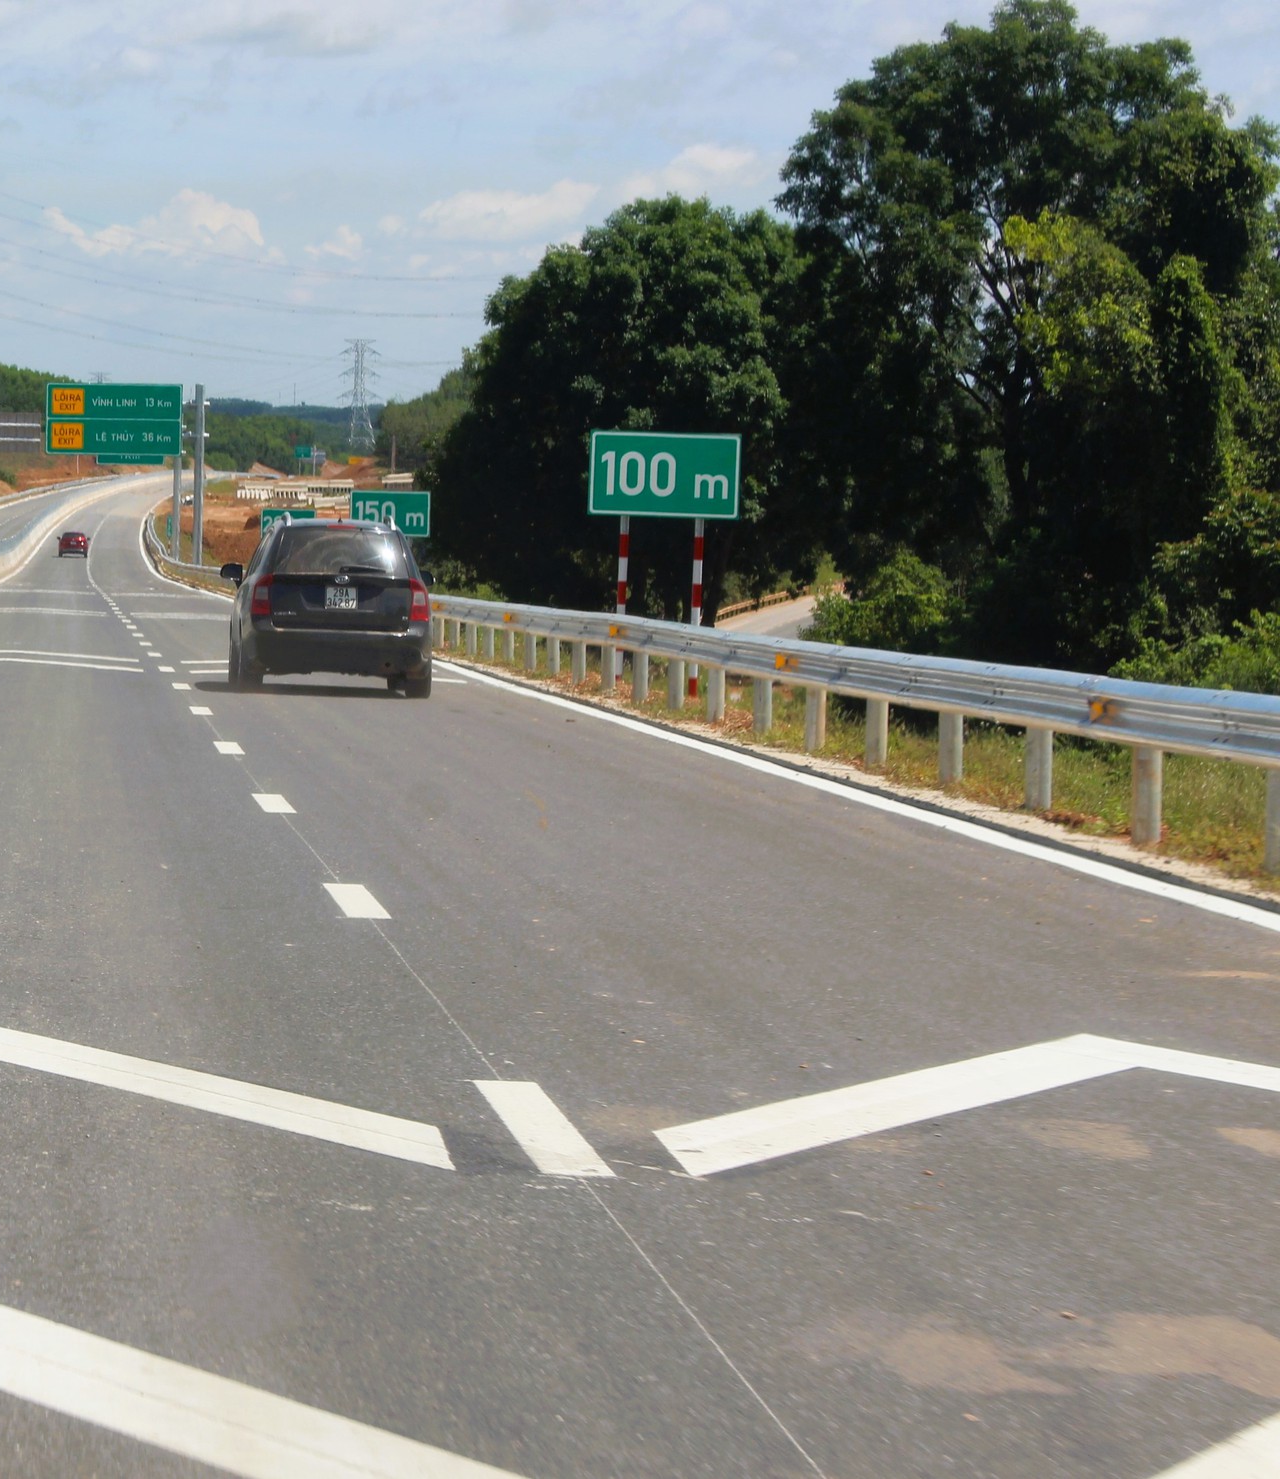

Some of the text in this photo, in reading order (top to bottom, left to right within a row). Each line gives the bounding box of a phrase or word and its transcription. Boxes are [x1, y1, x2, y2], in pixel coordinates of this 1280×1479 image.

[69, 393, 82, 401] RA
[116, 398, 137, 407] LINH
[145, 397, 155, 407] 13
[157, 399, 172, 407] Km
[59, 403, 76, 411] EXIT
[69, 428, 81, 436] RA
[142, 431, 154, 442] 36
[157, 434, 172, 443] Km
[58, 437, 74, 445] EXIT
[601, 451, 728, 499] 100 m
[355, 500, 425, 527] 150 m
[333, 588, 350, 598] 29A
